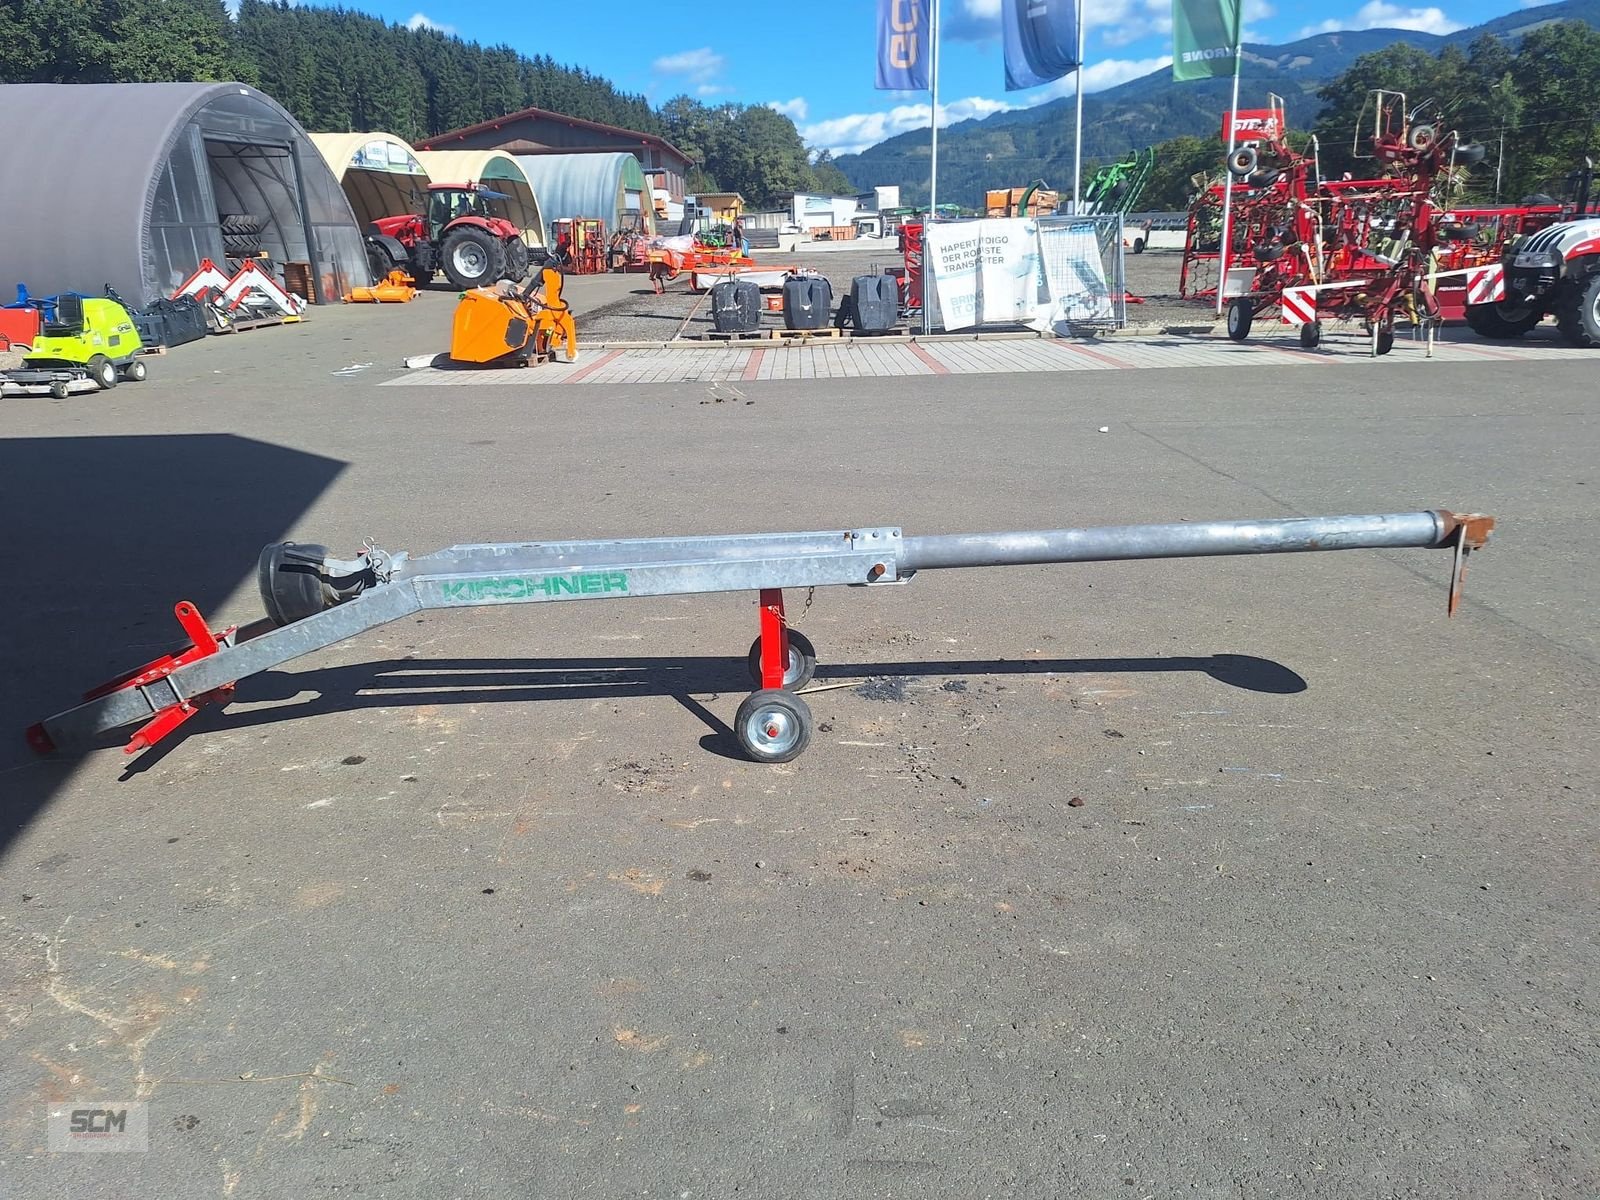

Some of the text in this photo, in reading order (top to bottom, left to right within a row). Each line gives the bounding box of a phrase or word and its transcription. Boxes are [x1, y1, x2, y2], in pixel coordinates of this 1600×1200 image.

[940, 239, 977, 253] HAPERT
[942, 253, 961, 263] DER
[442, 572, 628, 600] KIRCHNER
